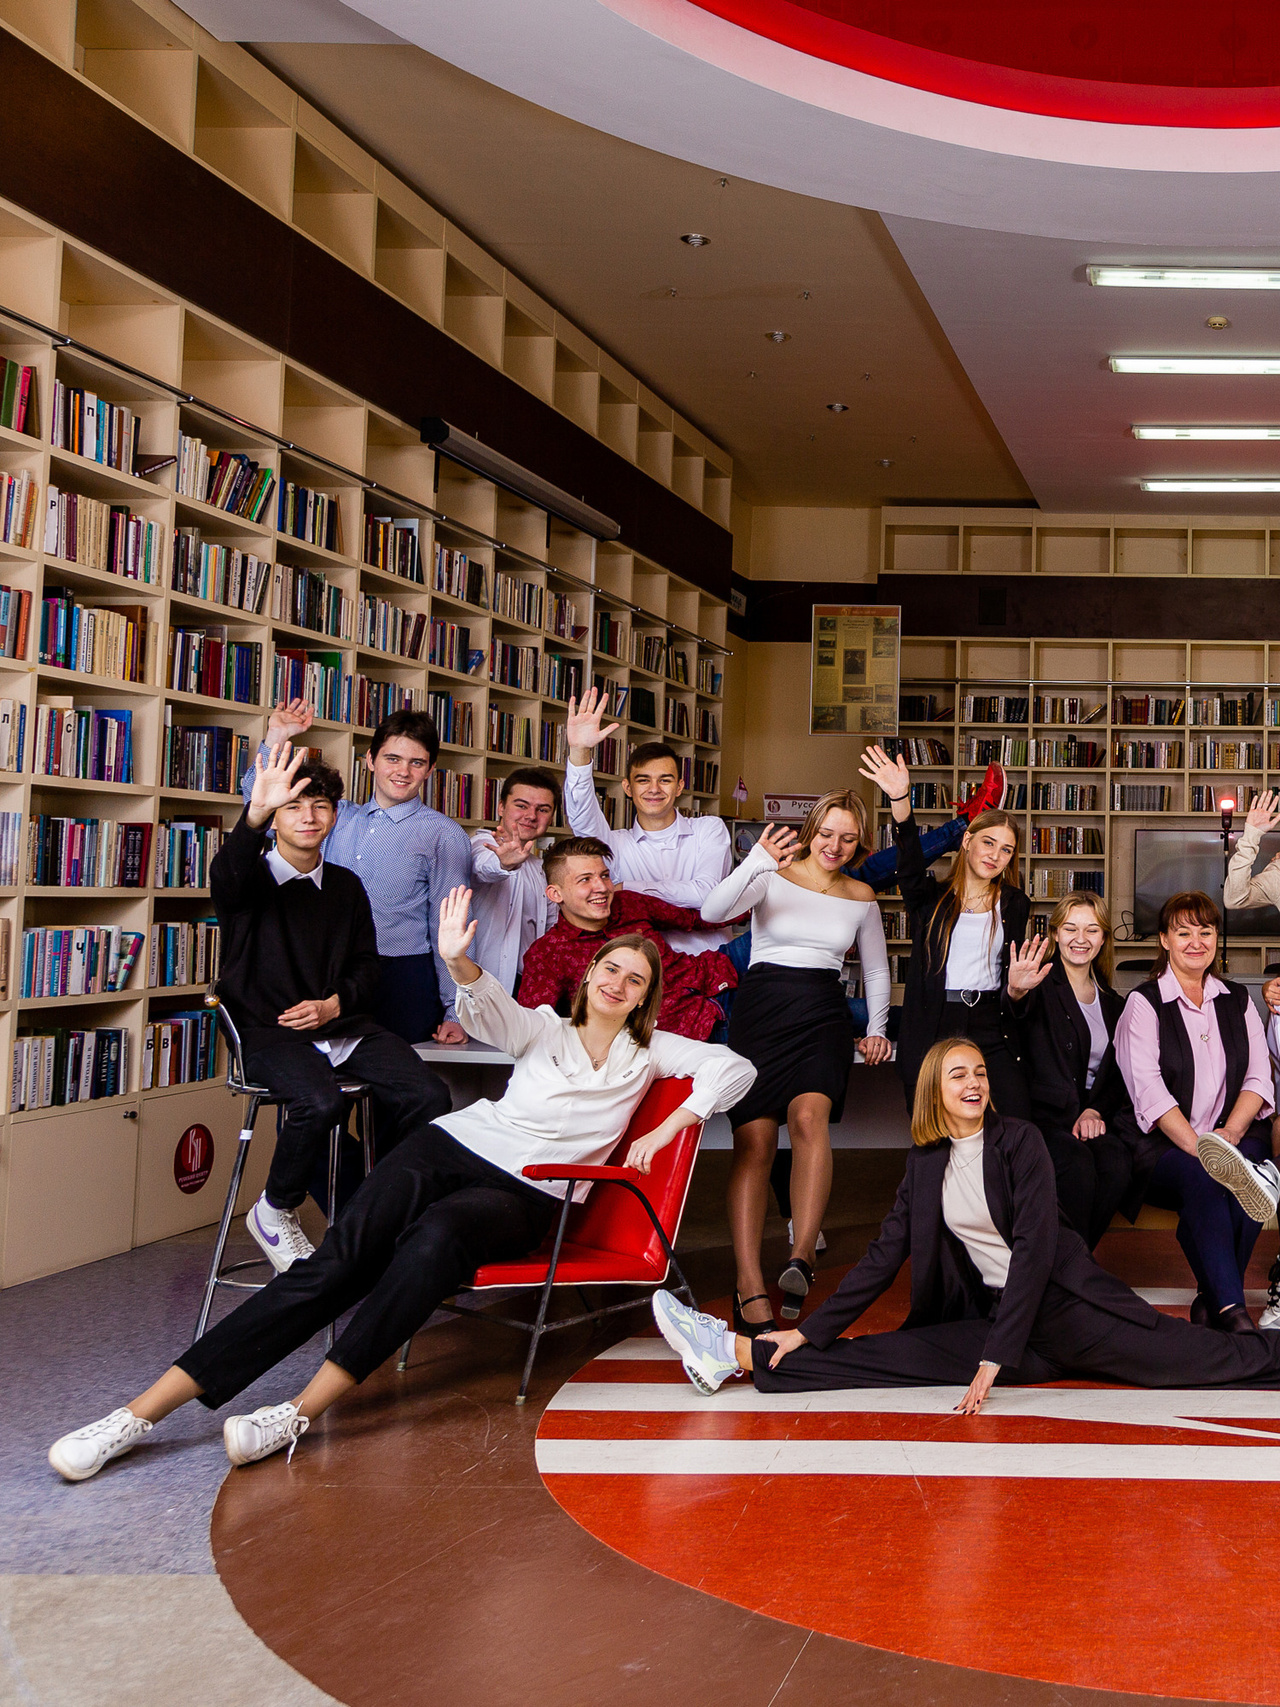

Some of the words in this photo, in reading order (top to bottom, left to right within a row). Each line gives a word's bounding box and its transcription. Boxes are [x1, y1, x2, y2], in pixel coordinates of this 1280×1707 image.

[50, 500, 57, 510] Р
[2, 713, 10, 724] Л
[66, 723, 73, 734] С
[76, 942, 85, 954] Ч
[45, 934, 54, 986] ХРЕСТОМАТИЯ
[146, 1038, 154, 1050] Б
[162, 1038, 169, 1048] В
[11, 1049, 19, 1104] БАРАТЫНСКИЙ
